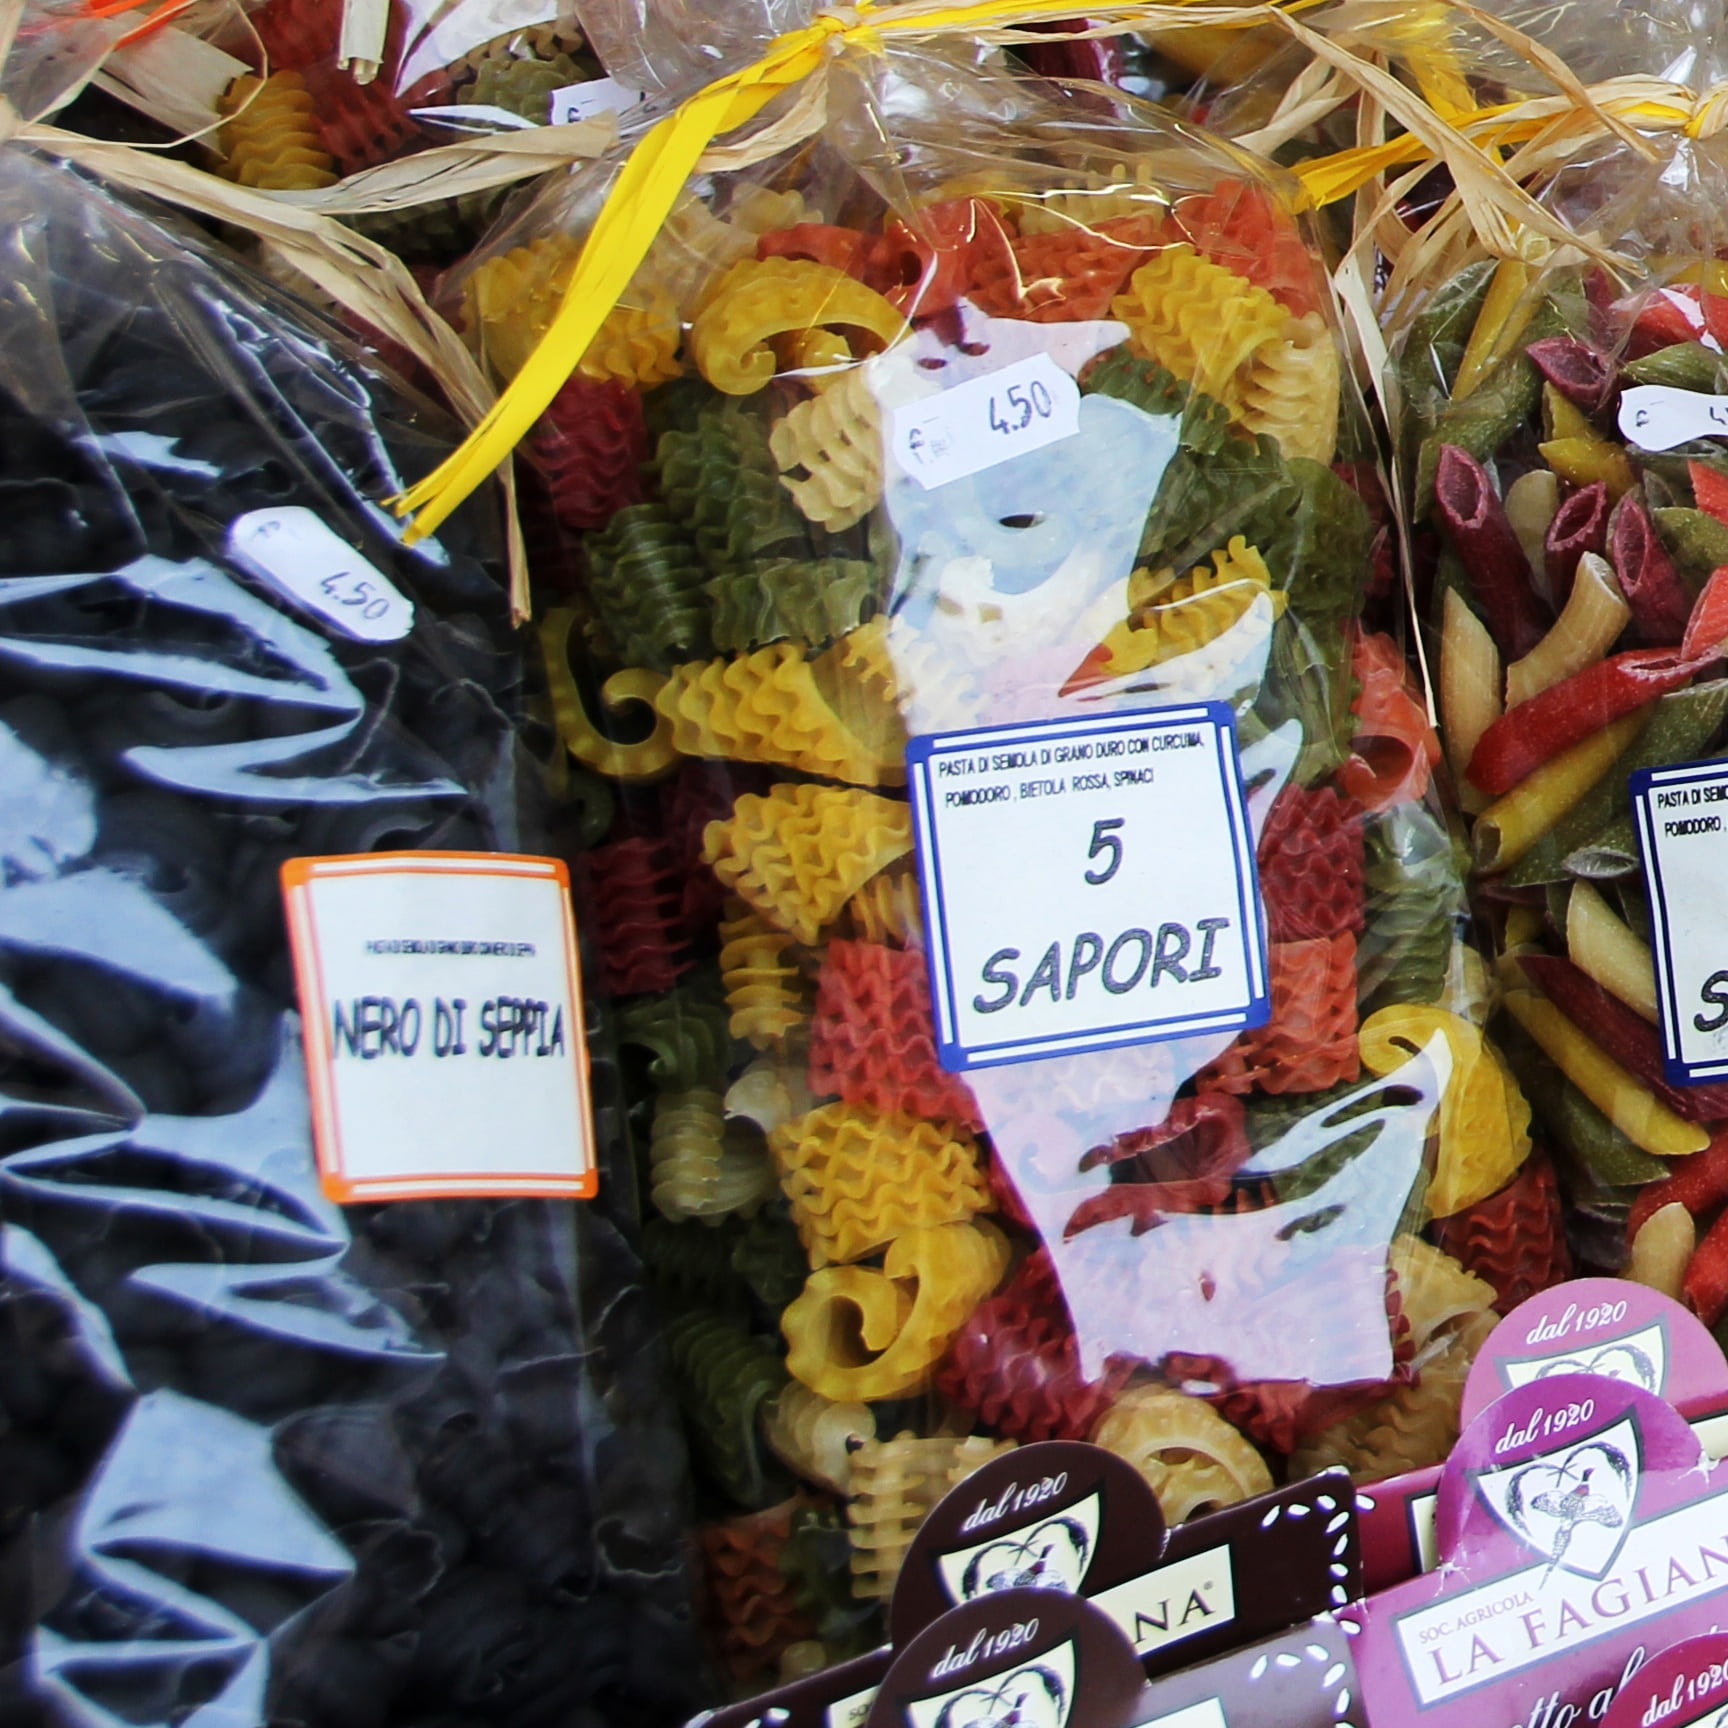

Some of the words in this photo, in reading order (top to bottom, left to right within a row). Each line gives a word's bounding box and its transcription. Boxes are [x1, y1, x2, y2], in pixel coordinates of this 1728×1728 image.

[989, 380, 1053, 435] 4.50
[317, 569, 394, 622] 4.50
[939, 757, 976, 779] PASTA
[978, 754, 990, 773] DI
[992, 750, 1038, 771] SEMOLA
[1040, 747, 1052, 766] DI
[1054, 742, 1094, 764] GRANO
[1095, 740, 1126, 759] DURO
[1127, 737, 1150, 755] CON
[1657, 790, 1690, 810] PASTA
[1691, 787, 1702, 805] DI
[1084, 816, 1126, 886] 5
[972, 916, 1231, 1015] SAPORI
[331, 994, 422, 1061] NERO
[433, 994, 468, 1058] DI
[479, 994, 567, 1058] SEPPIA
[1524, 1307, 1574, 1347] dal
[1574, 1299, 1628, 1336] 1920
[1494, 1405, 1541, 1455] dal
[1542, 1397, 1596, 1437] 1920
[1418, 1618, 1454, 1645] SOC.
[1455, 1591, 1534, 1635] AGRICOLA
[1427, 1633, 1502, 1687] LA
